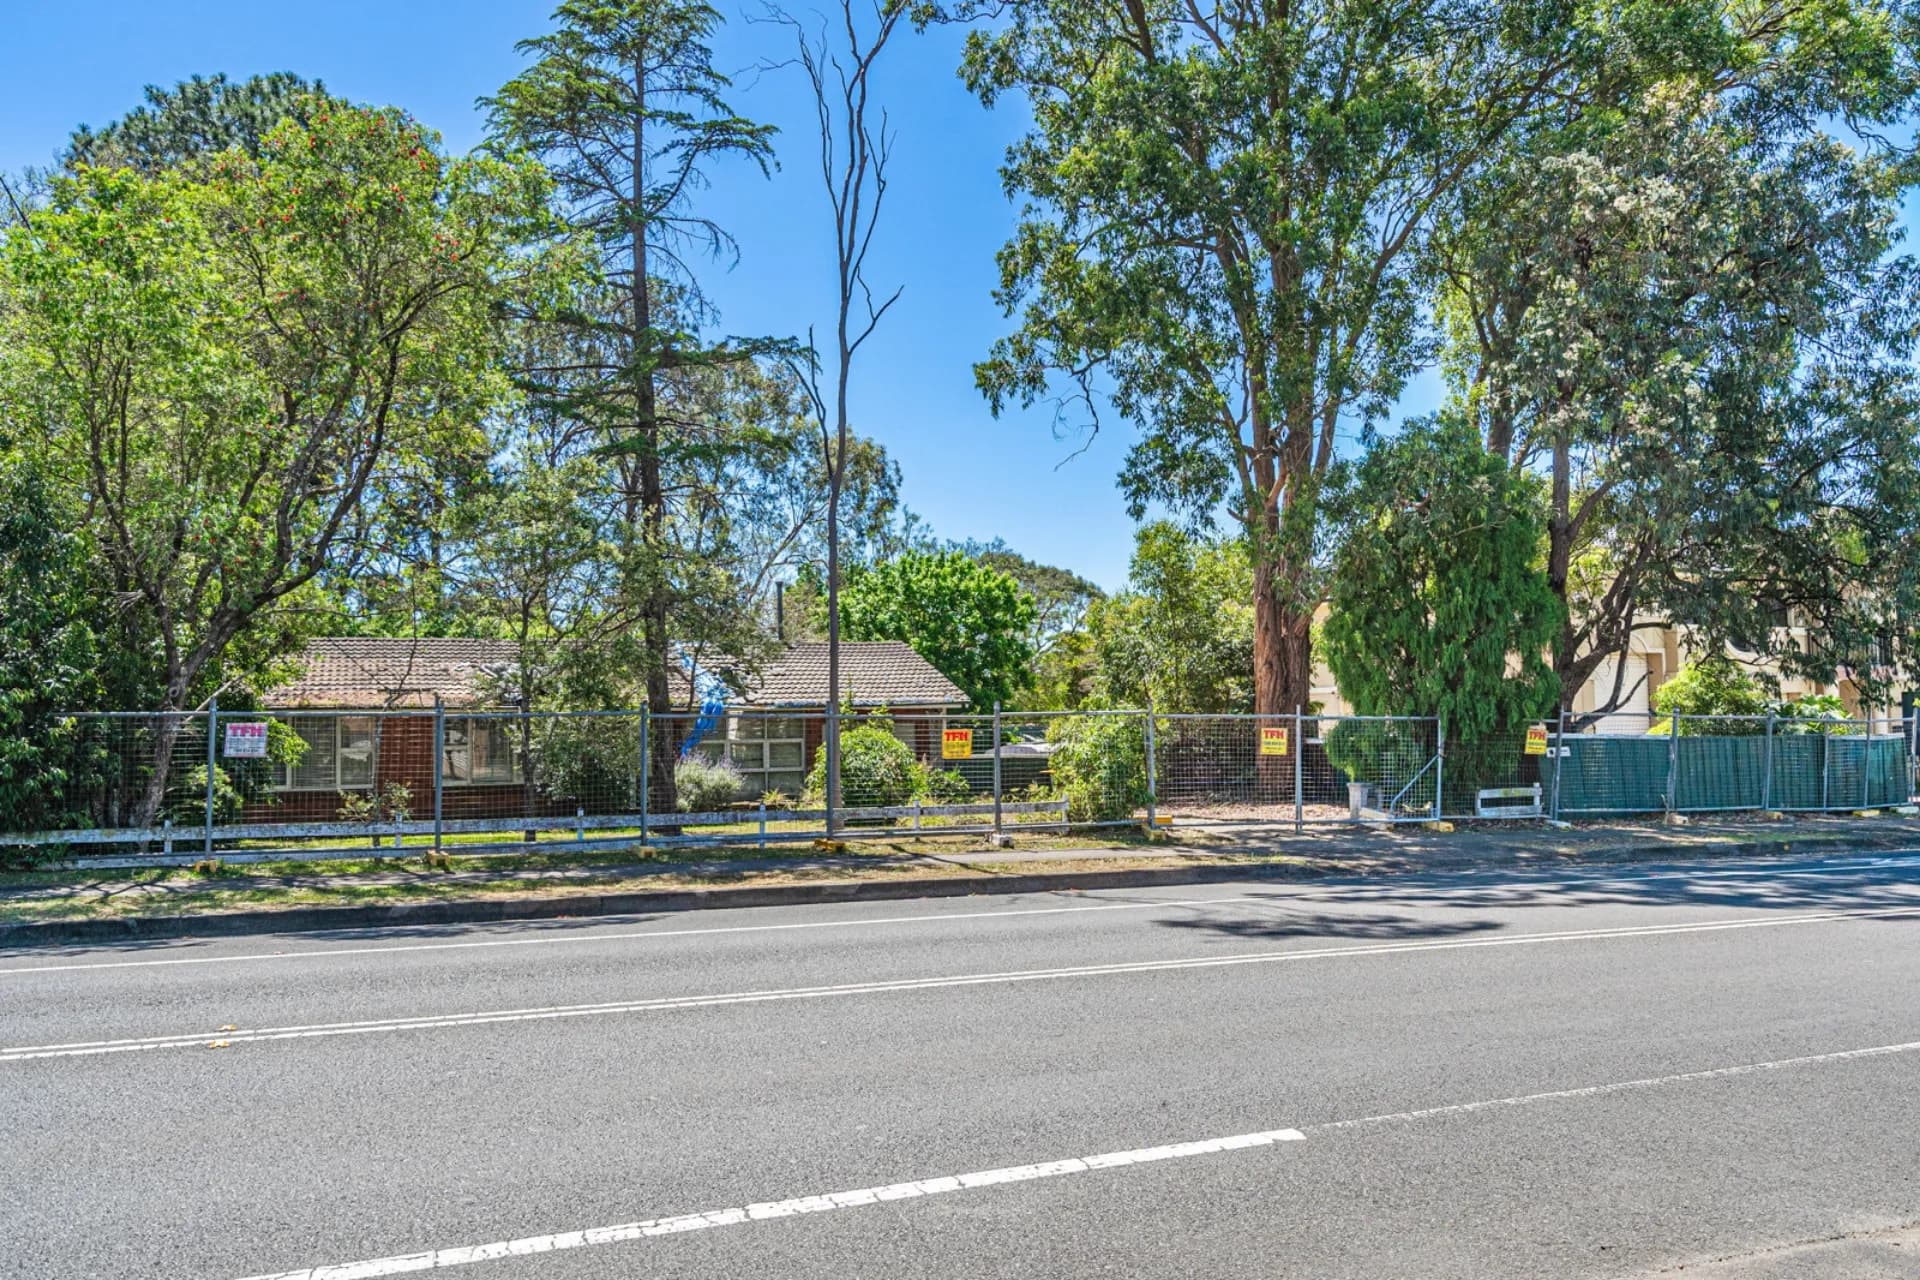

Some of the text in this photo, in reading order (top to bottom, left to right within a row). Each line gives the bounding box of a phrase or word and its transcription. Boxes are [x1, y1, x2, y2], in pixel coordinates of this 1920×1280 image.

[229, 725, 263, 737] TFH
[1264, 730, 1284, 739] TFH
[944, 732, 968, 741] TFH
[1529, 731, 1545, 741] TFH
